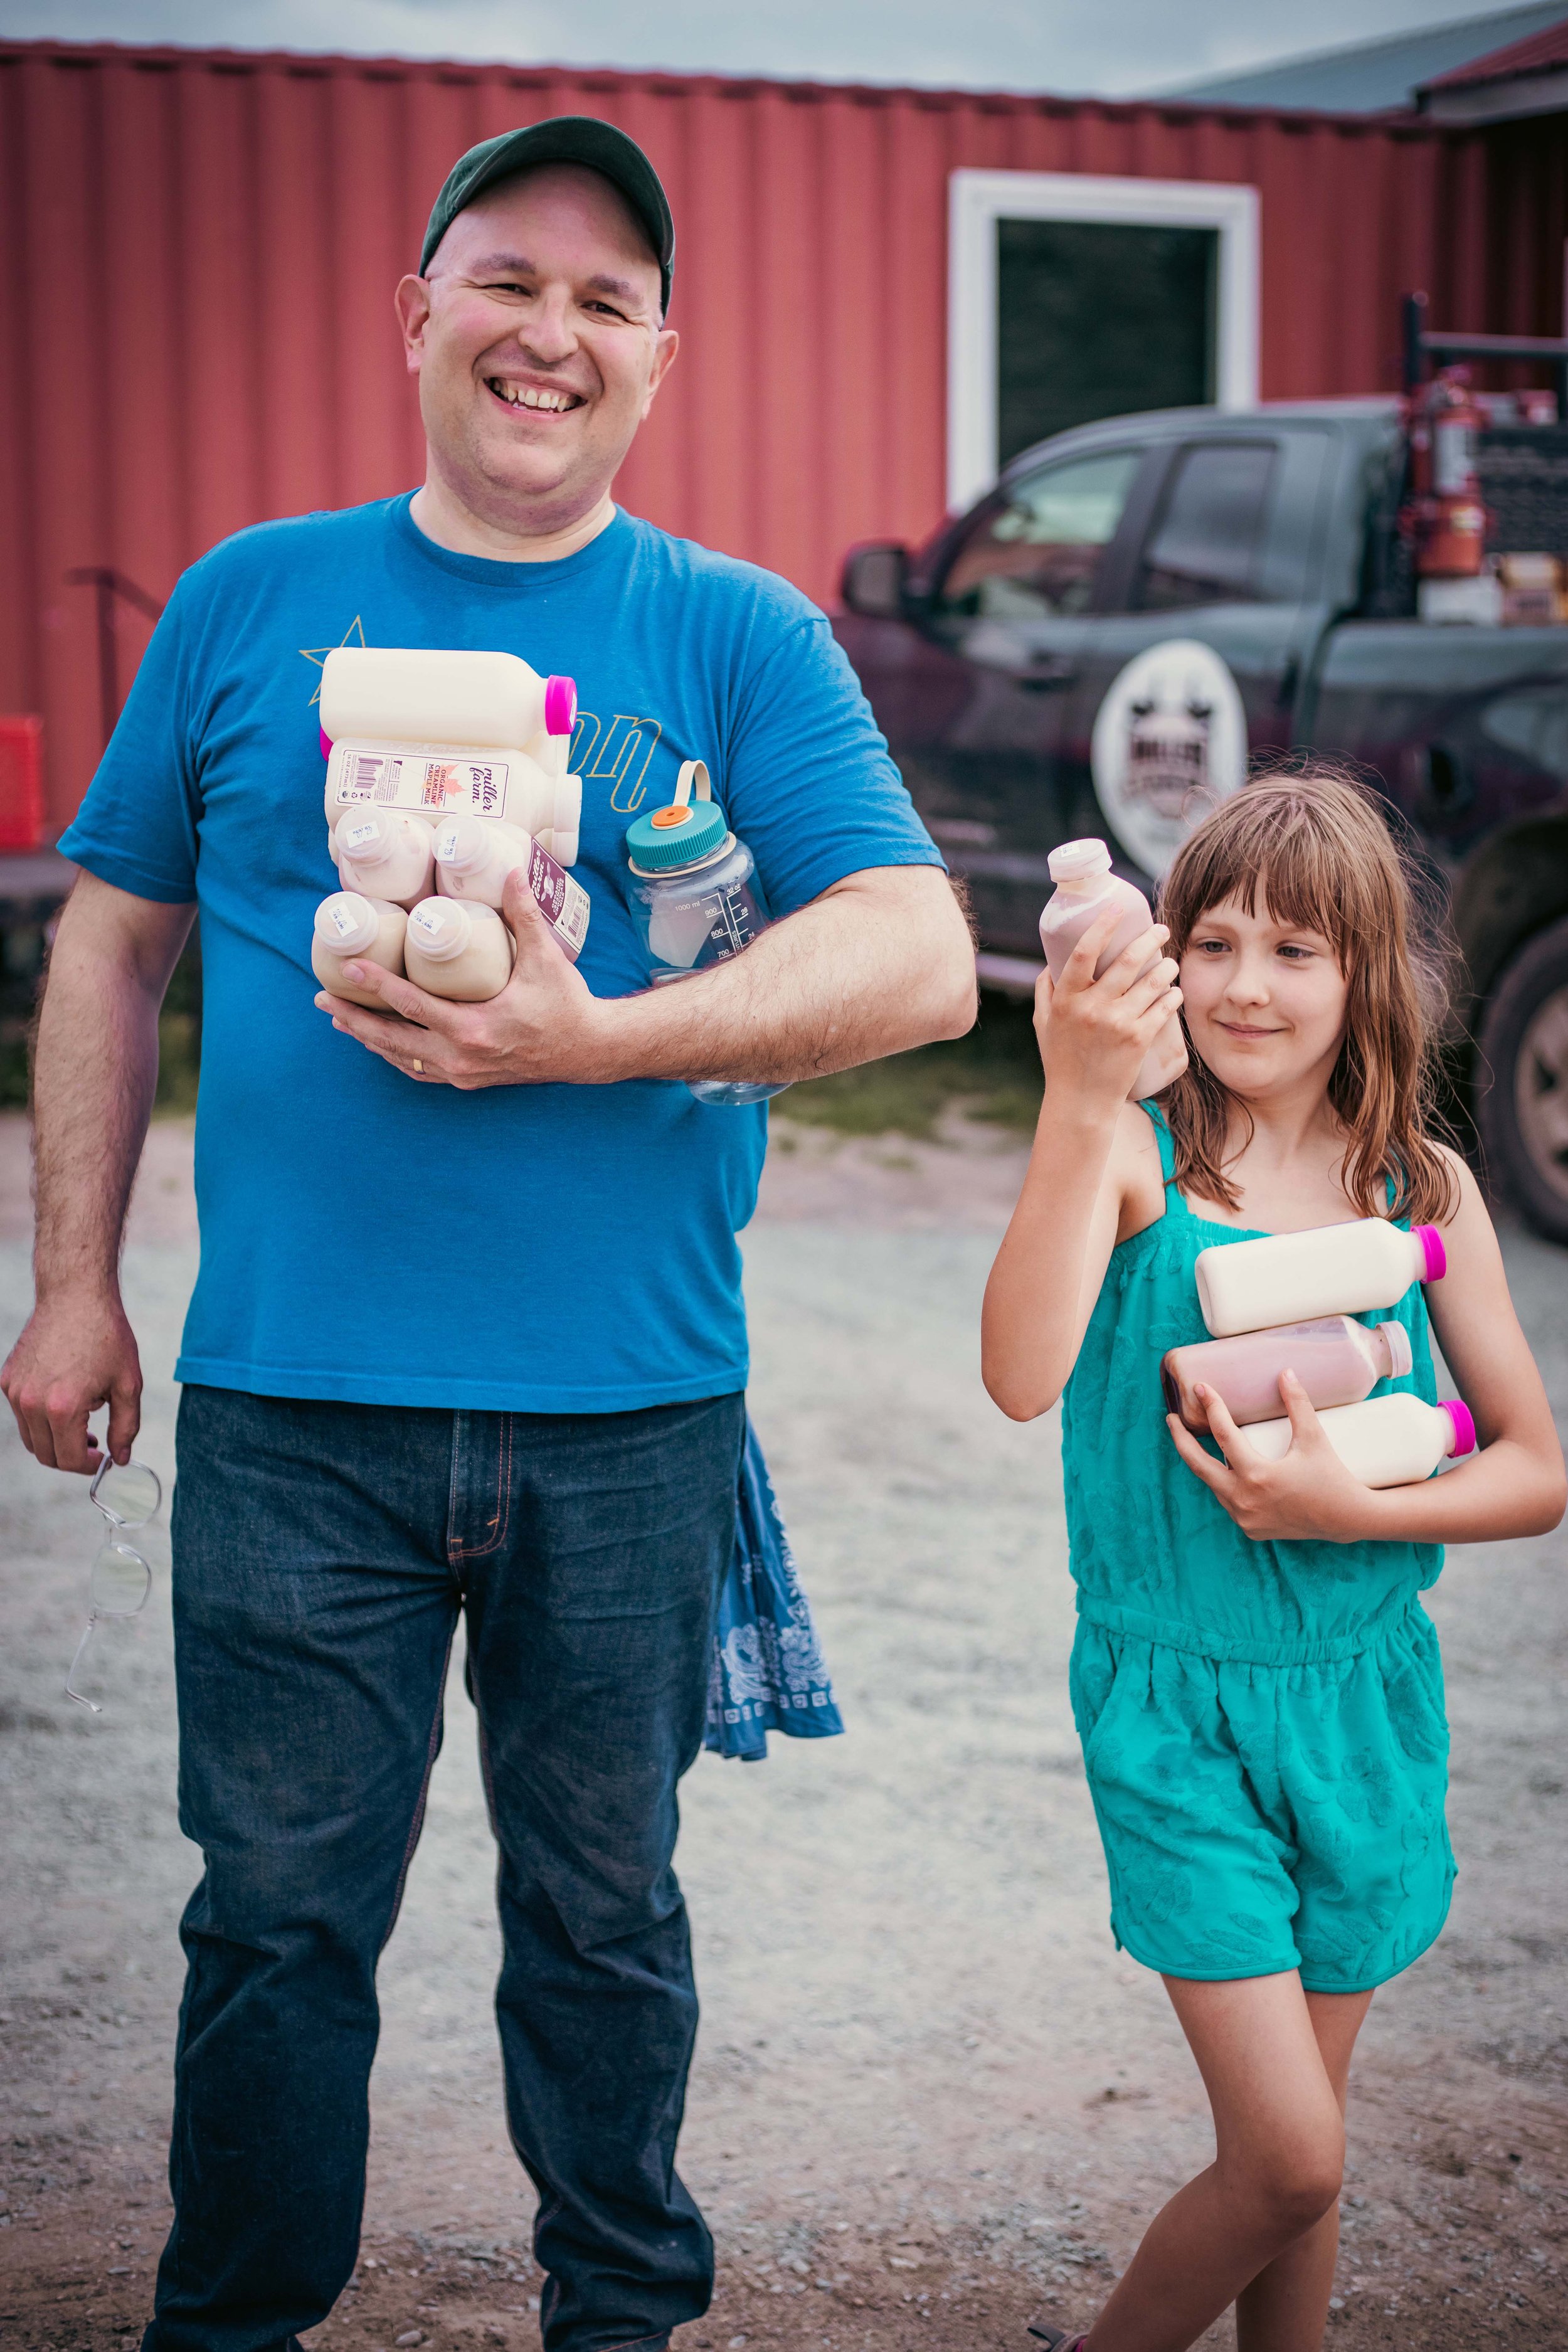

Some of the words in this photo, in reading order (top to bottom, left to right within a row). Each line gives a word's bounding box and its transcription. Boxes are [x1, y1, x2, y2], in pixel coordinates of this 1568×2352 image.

[431, 765, 440, 804] CREAMLINE
[437, 770, 447, 801] ORGANIC
[469, 767, 484, 803] farm.
[483, 768, 497, 812] miller
[531, 849, 541, 894] miller
[705, 908, 717, 916] 900
[741, 907, 748, 915] 28
[711, 928, 723, 937] 800
[748, 931, 755, 940] 24
[718, 949, 729, 958] 700
